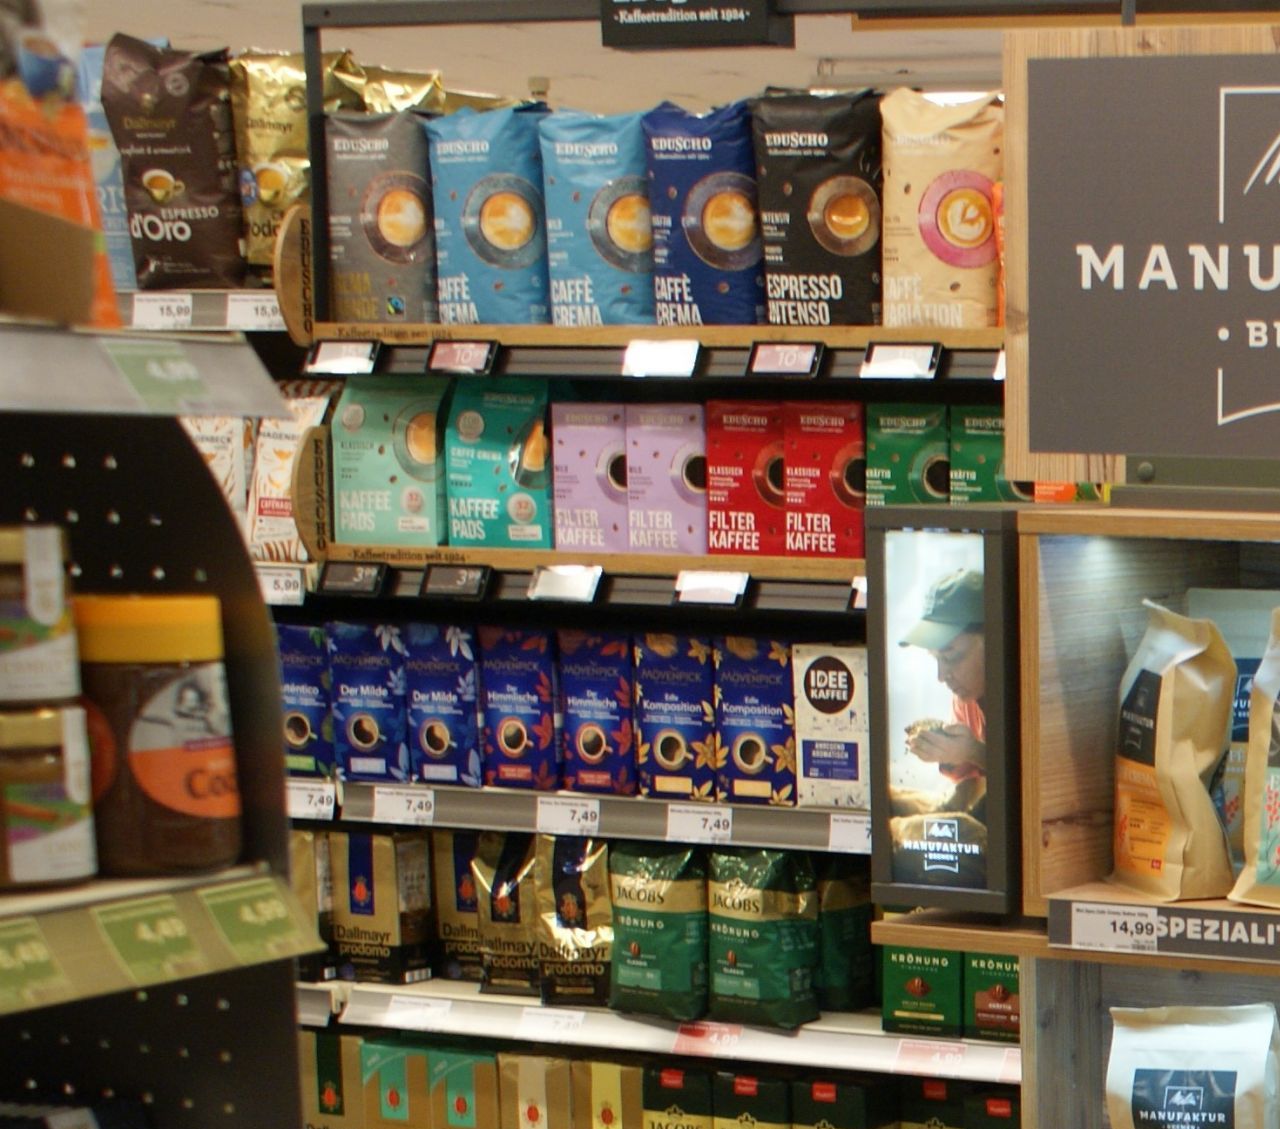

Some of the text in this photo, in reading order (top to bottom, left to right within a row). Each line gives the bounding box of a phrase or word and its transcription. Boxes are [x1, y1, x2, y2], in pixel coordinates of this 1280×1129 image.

[700, 8, 719, 21] seit
[334, 138, 389, 151] EDUSCHO
[652, 136, 711, 151] EDUSCHO
[765, 132, 829, 147] EDUSCHO
[161, 205, 218, 220] ESPRESSO
[131, 211, 192, 242] d'Oro
[767, 274, 842, 299] ESPRESSO
[769, 303, 830, 325] INTENSO
[723, 415, 768, 427] EDUSCHO
[800, 415, 845, 427] EDUSCHO
[879, 416, 926, 428] EDUSCHO
[450, 499, 499, 518] KAFFEE
[340, 513, 376, 532] PADS
[556, 508, 599, 527] FILTER
[630, 509, 673, 528] FILTER
[709, 511, 755, 531] FILTER
[786, 513, 831, 532] FILTER
[452, 521, 486, 540] PADS
[557, 528, 605, 547] KAFFEE
[630, 529, 678, 548] KAFFEE
[709, 530, 760, 551] KAFFEE
[786, 531, 836, 553] KAFFEE
[353, 550, 423, 561] Kaffeetradition
[425, 553, 442, 561] seit
[810, 669, 848, 689] IDEE
[340, 684, 388, 697] Der Milde
[413, 691, 458, 703] Der Milde
[810, 688, 848, 701] KAFFEE
[643, 701, 702, 715] Komposition
[722, 704, 783, 718] Komposition
[406, 800, 432, 812] 7,49
[569, 810, 597, 822] 7,49
[701, 818, 730, 832] 7,49
[904, 841, 980, 855] MANUFAKTUR
[617, 886, 664, 904] JACOBS
[714, 892, 759, 912] JACOBS
[336, 925, 391, 943] Dallmayr
[712, 922, 758, 939] KRÖNUNG
[1109, 921, 1155, 937] 14,99
[339, 943, 391, 958] prodomo
[892, 953, 949, 967] KRÖNUNG
[544, 961, 604, 976] prodomo
[1140, 1110, 1225, 1123] MANUFAKTUR
